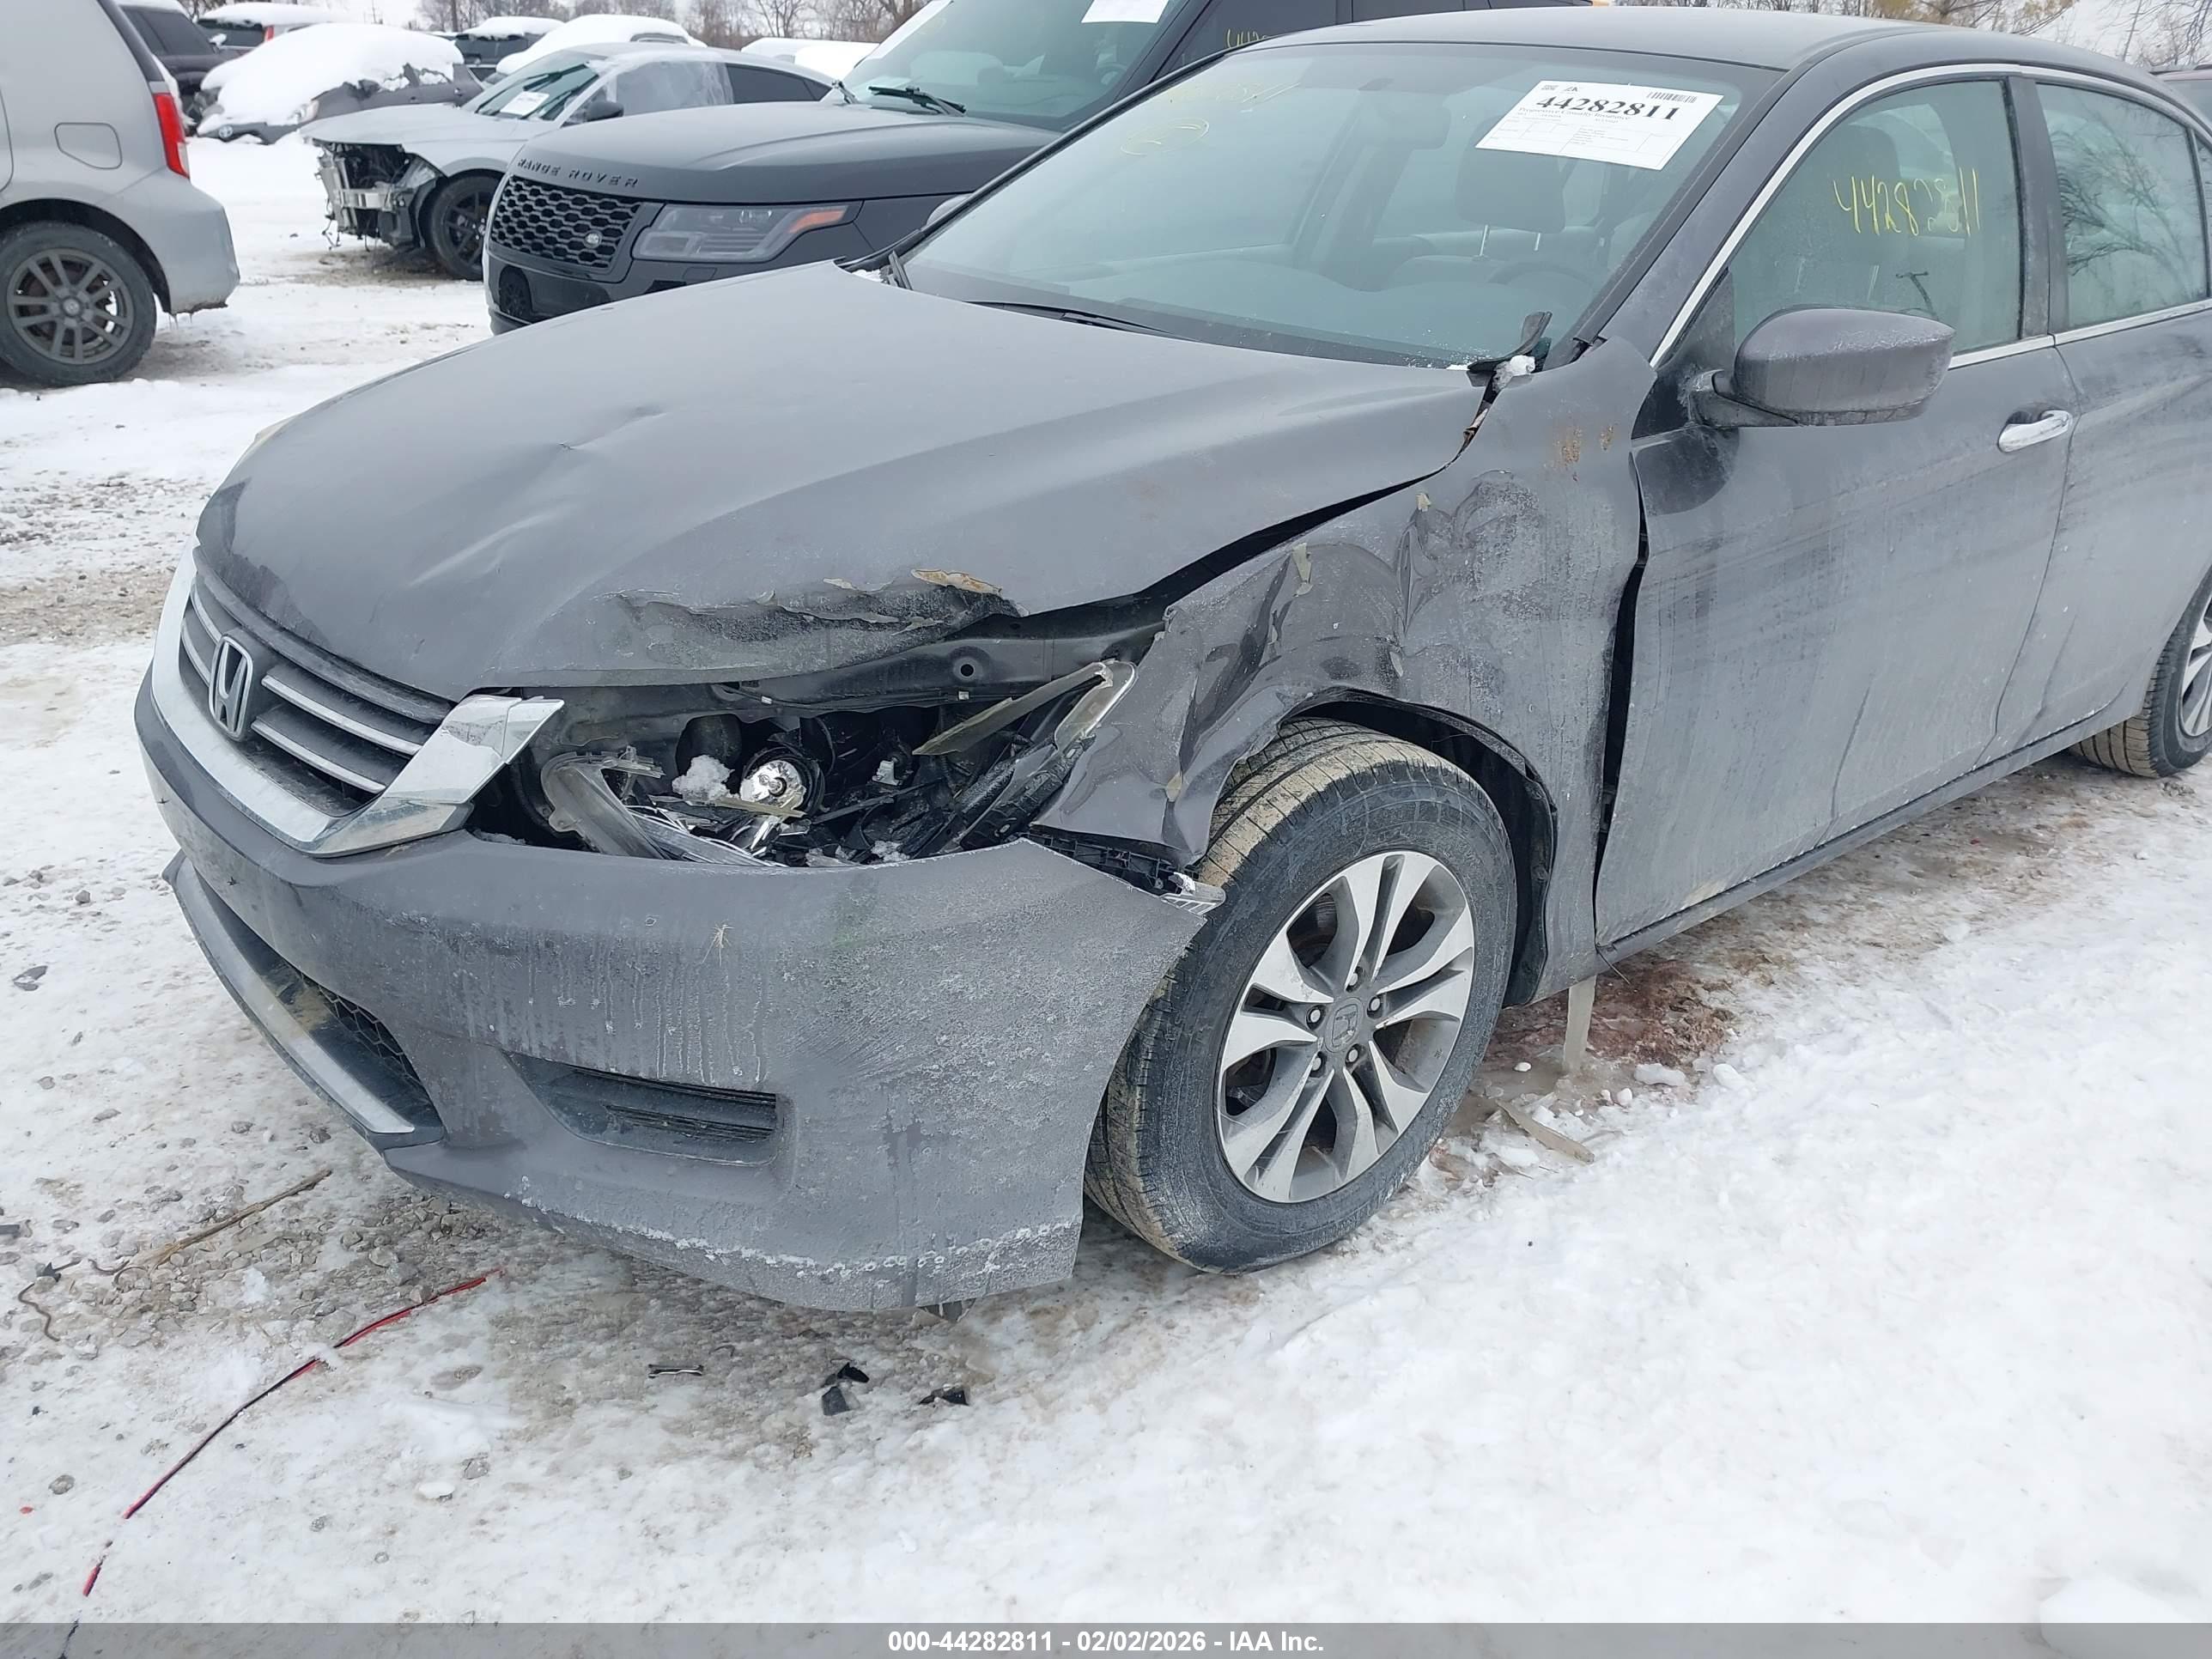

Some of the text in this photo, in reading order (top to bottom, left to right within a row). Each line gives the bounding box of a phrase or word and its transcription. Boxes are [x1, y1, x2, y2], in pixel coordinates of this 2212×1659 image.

[1536, 95, 1680, 121] 44282811
[517, 158, 639, 188] RANGE ROVER
